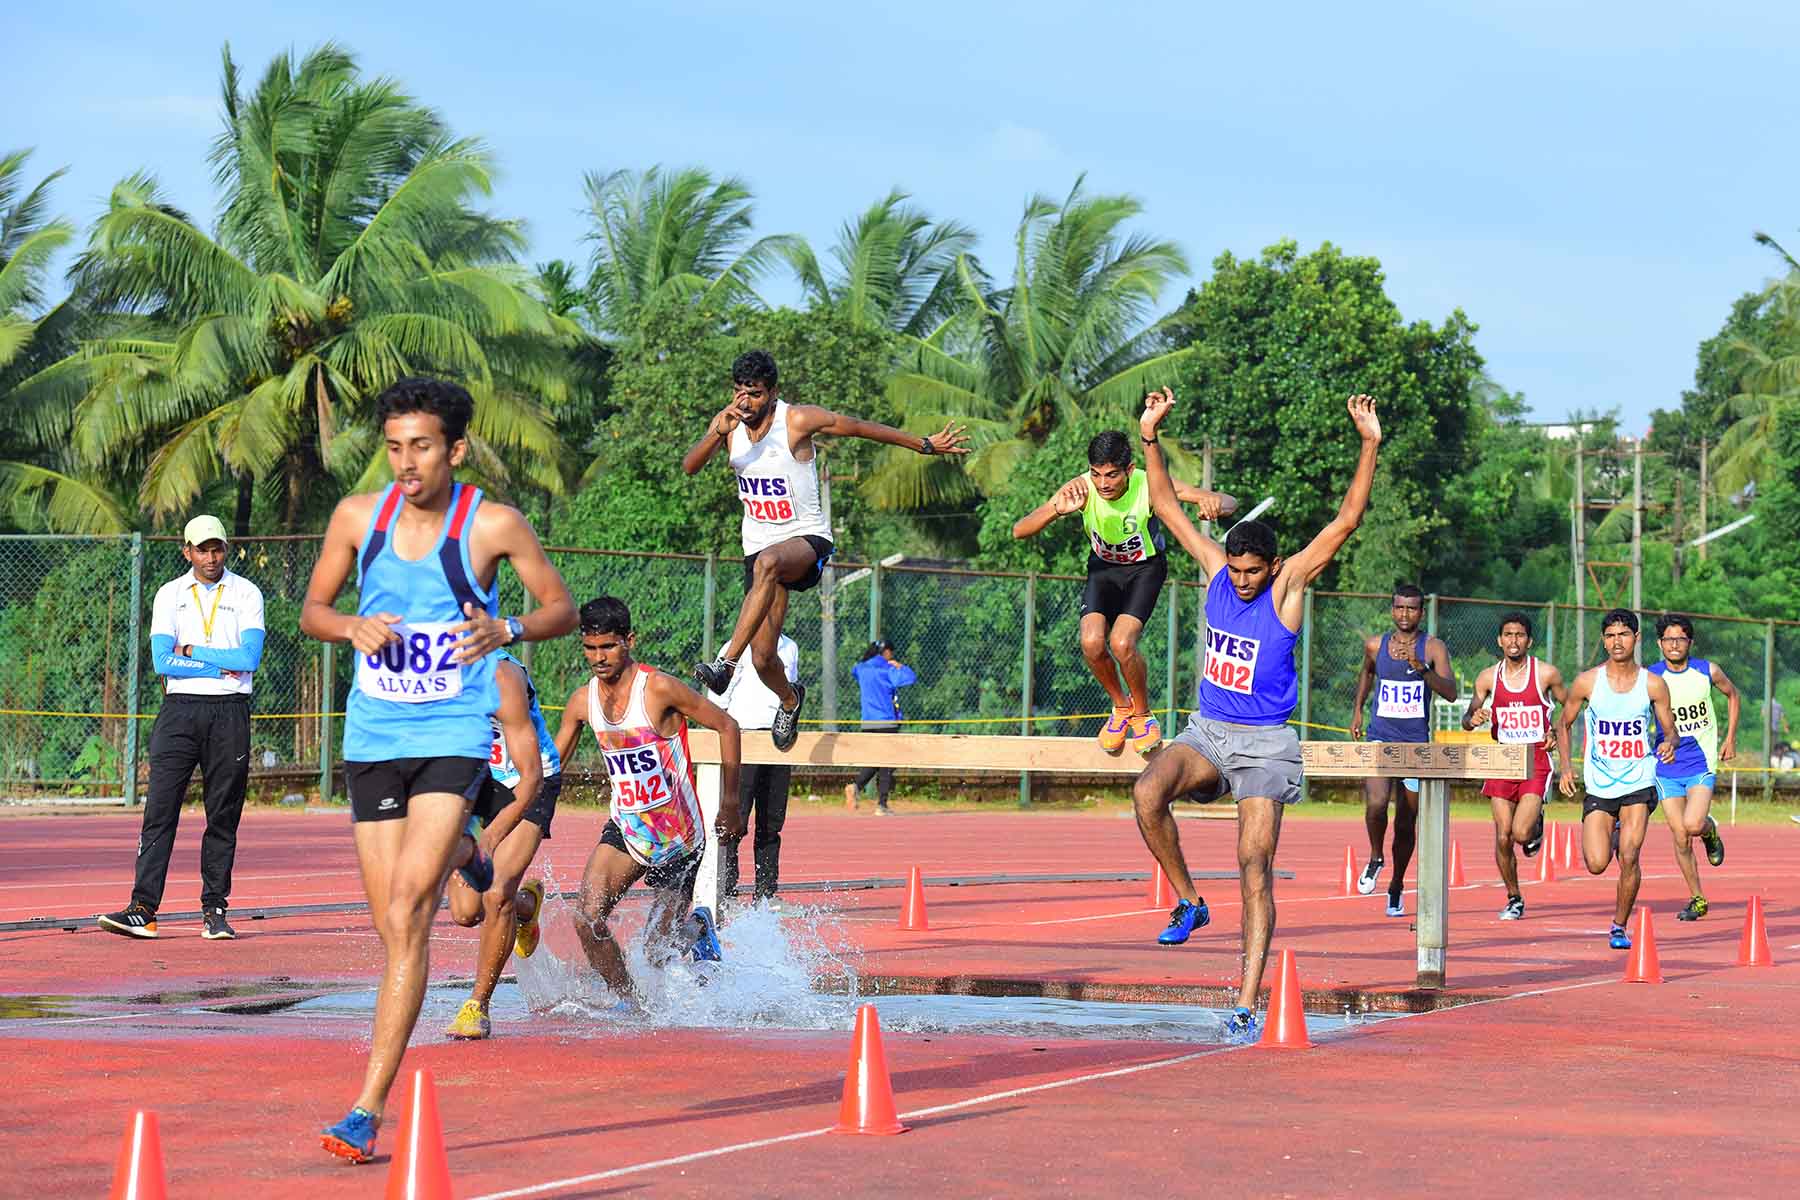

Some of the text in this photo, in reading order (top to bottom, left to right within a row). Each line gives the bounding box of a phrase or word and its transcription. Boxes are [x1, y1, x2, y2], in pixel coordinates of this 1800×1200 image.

[738, 475, 787, 496] DYES
[743, 498, 793, 520] 1208
[377, 676, 448, 694] ALVA'S
[1382, 684, 1422, 704] 6154
[1501, 710, 1540, 729] 2509
[1599, 720, 1642, 736] DYES
[1679, 717, 1709, 733] LVA'S
[1599, 740, 1645, 758] 1280
